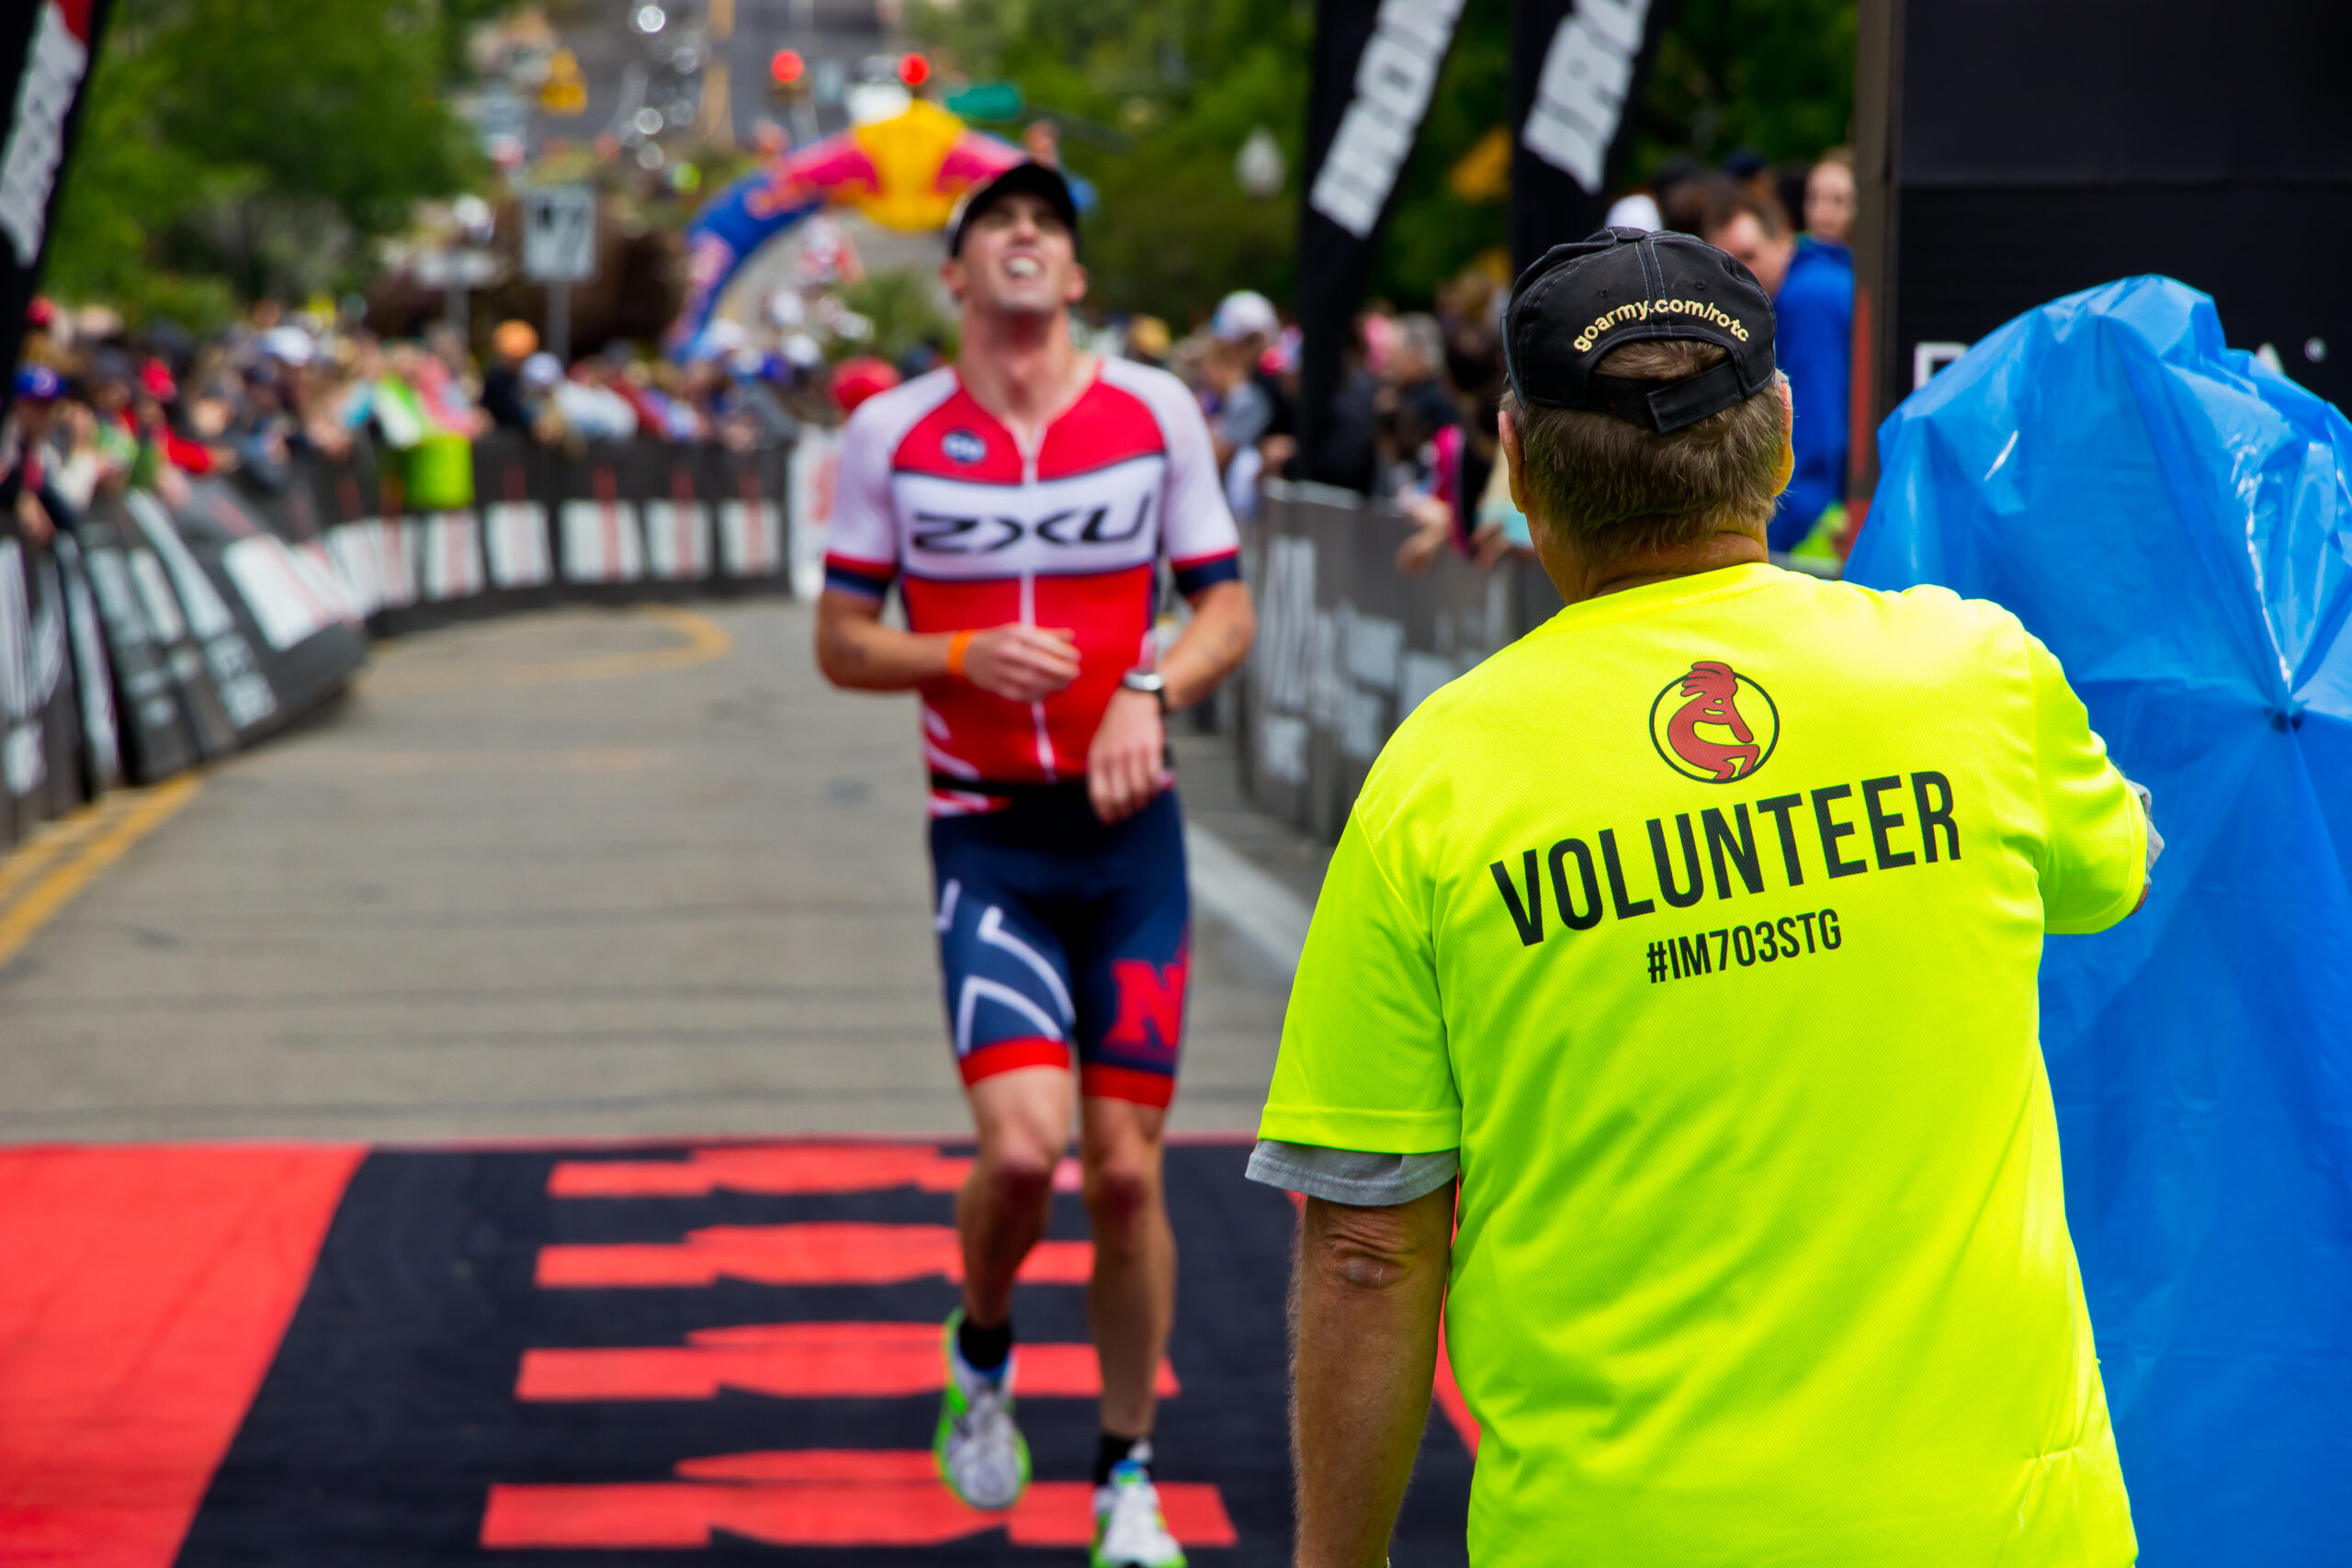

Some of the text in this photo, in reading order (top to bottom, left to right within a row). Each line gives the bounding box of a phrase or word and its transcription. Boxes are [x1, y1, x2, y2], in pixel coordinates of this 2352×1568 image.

[1573, 299, 1749, 353] goarmy.com/rotc
[1489, 771, 1962, 947] VOLUNTEER
[1646, 908, 1842, 984] #IM703STG
